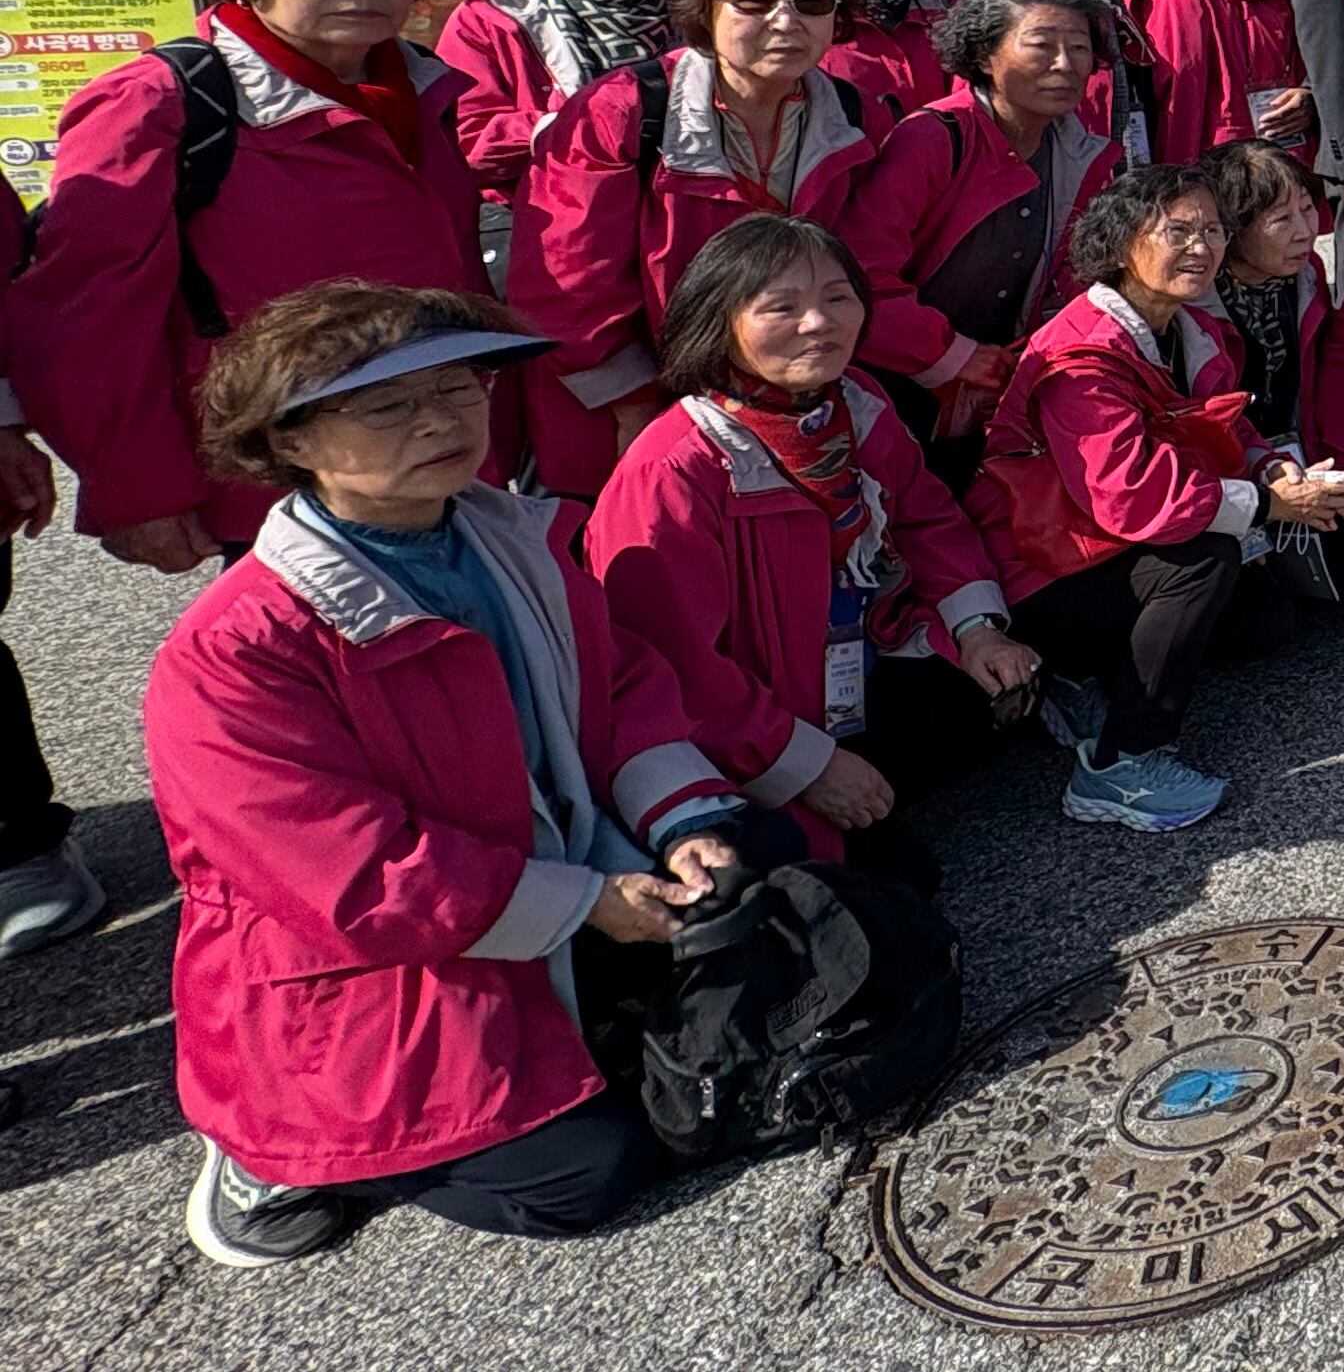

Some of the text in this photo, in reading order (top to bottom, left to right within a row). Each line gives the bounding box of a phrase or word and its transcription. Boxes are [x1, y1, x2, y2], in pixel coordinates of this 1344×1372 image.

[24, 34, 140, 52] 사곡역 방면
[38, 60, 88, 73] 960번
[1173, 929, 1300, 970] 오수
[1025, 1202, 1320, 1305] 구미시
